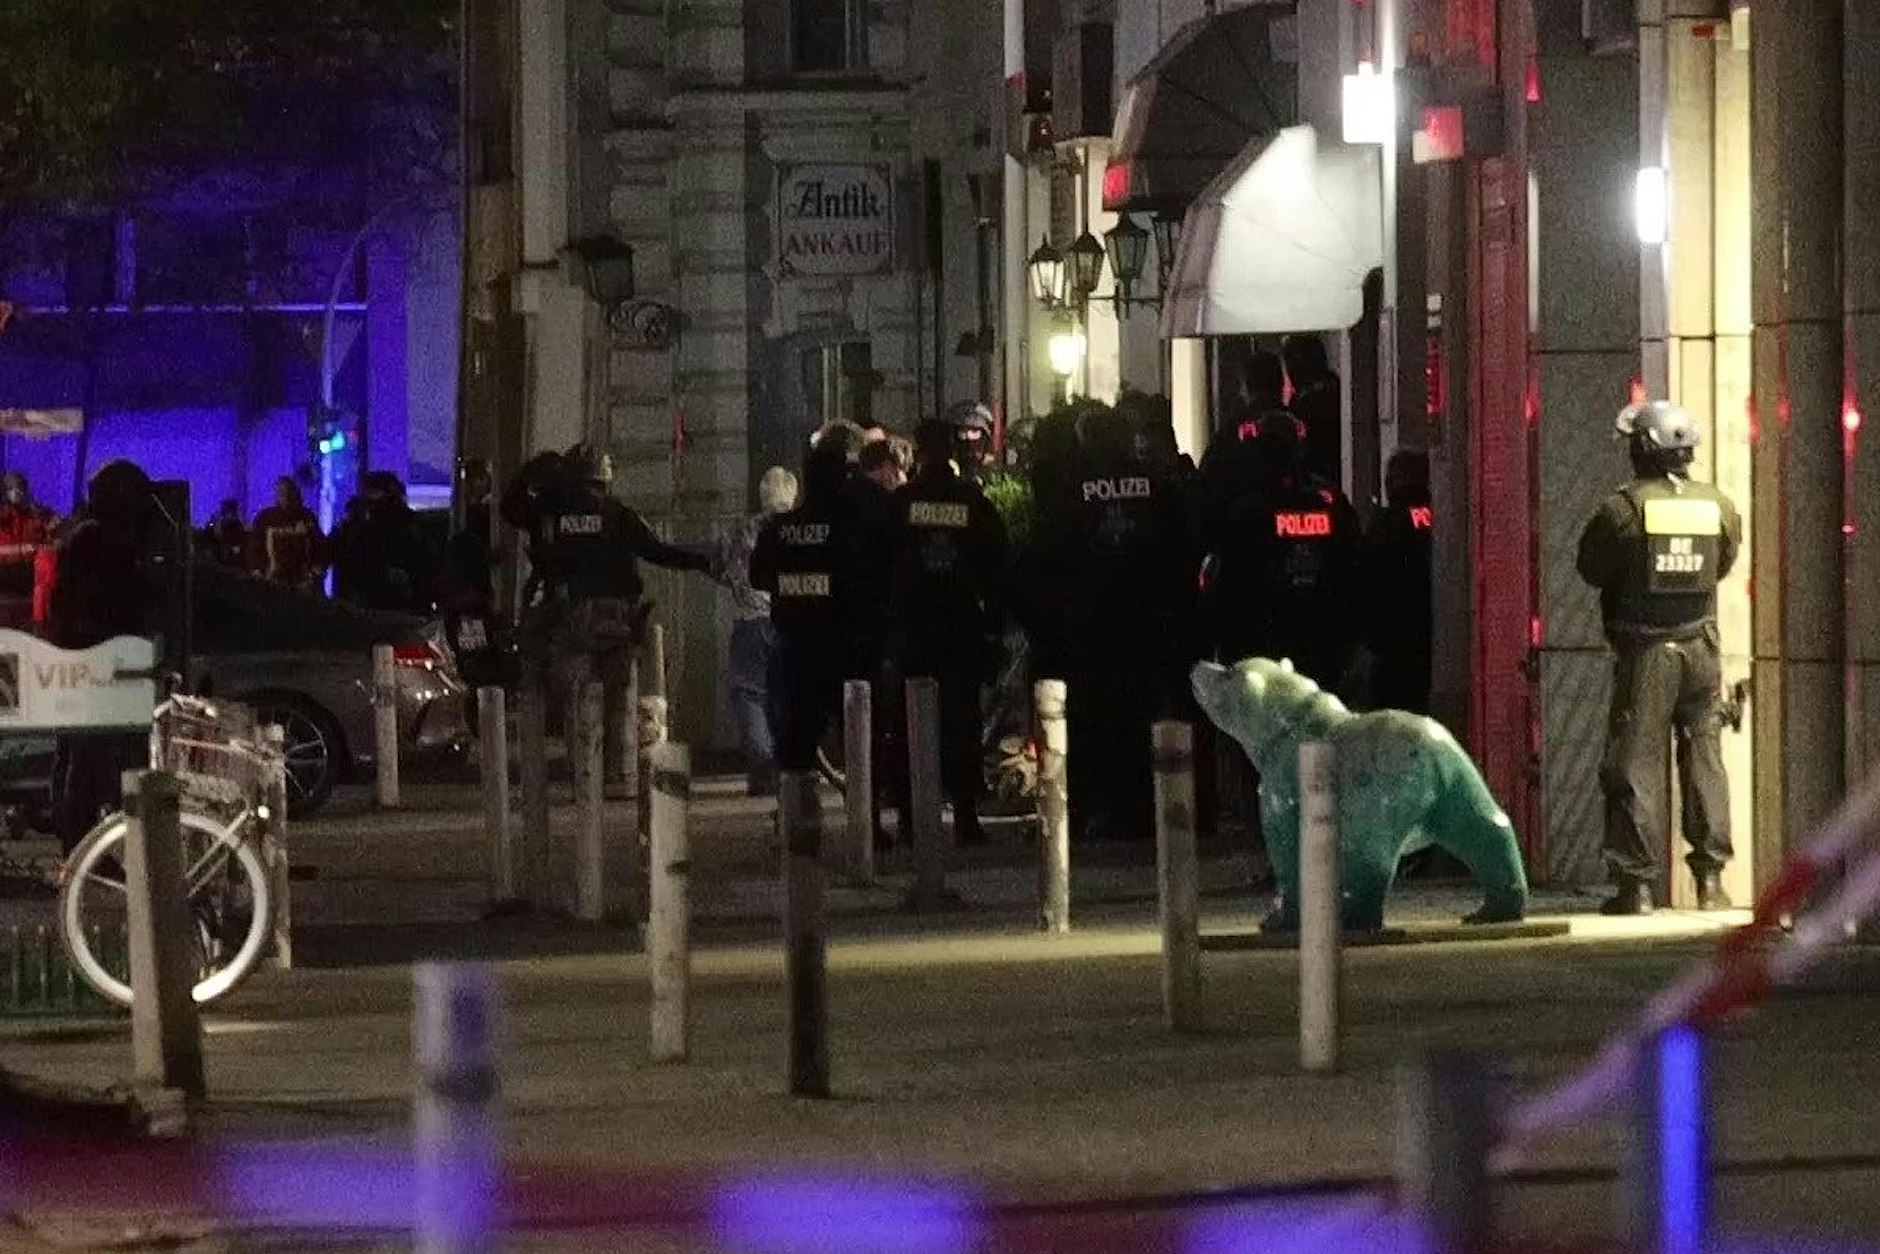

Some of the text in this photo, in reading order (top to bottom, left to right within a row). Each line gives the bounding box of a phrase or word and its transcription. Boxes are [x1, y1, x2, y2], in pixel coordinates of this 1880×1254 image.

[788, 180, 881, 218] Antik
[785, 231, 889, 257] ANKAUF
[1081, 477, 1151, 502] POLIZEI
[558, 514, 603, 533] POLIZEI
[1275, 513, 1331, 536] POLIZEI
[33, 662, 90, 689] VIP
